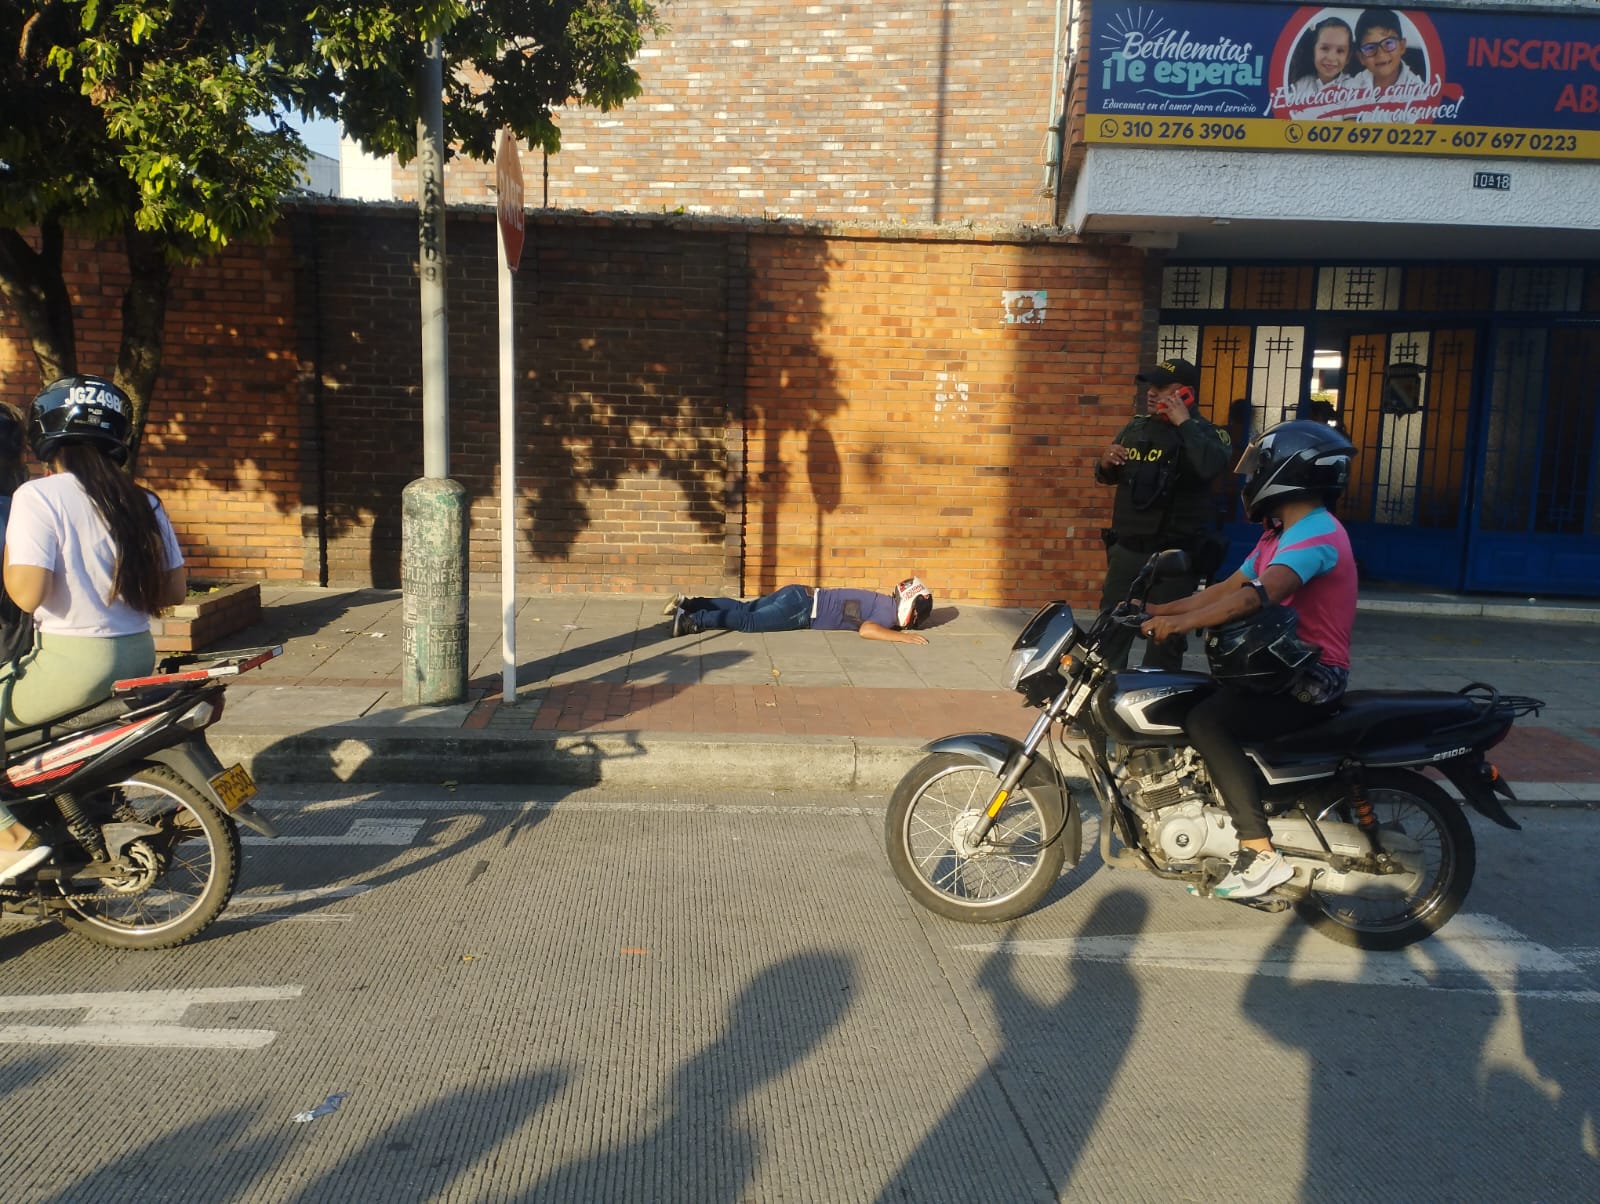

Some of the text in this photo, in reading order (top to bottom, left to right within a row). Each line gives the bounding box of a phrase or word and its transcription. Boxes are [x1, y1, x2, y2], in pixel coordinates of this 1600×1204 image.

[1121, 30, 1252, 63] Bethlemitas
[1102, 52, 1264, 91] ¡Te espera!
[1384, 73, 1442, 100] calidad
[1102, 98, 1146, 110] Educamos
[1159, 100, 1169, 110] el
[1169, 103, 1192, 111] amor
[1191, 103, 1213, 115] para
[1215, 101, 1225, 112] el
[1224, 102, 1257, 113] servicio
[1392, 96, 1464, 123] alcance!
[1122, 121, 1247, 140] 310 276 3906
[1307, 126, 1343, 142] 607
[1347, 127, 1383, 144] 697
[1387, 129, 1436, 146] 0227
[1452, 130, 1488, 147] 607
[1491, 132, 1526, 149] 697
[1529, 134, 1577, 151] 0223
[500, 169, 523, 232] PARE
